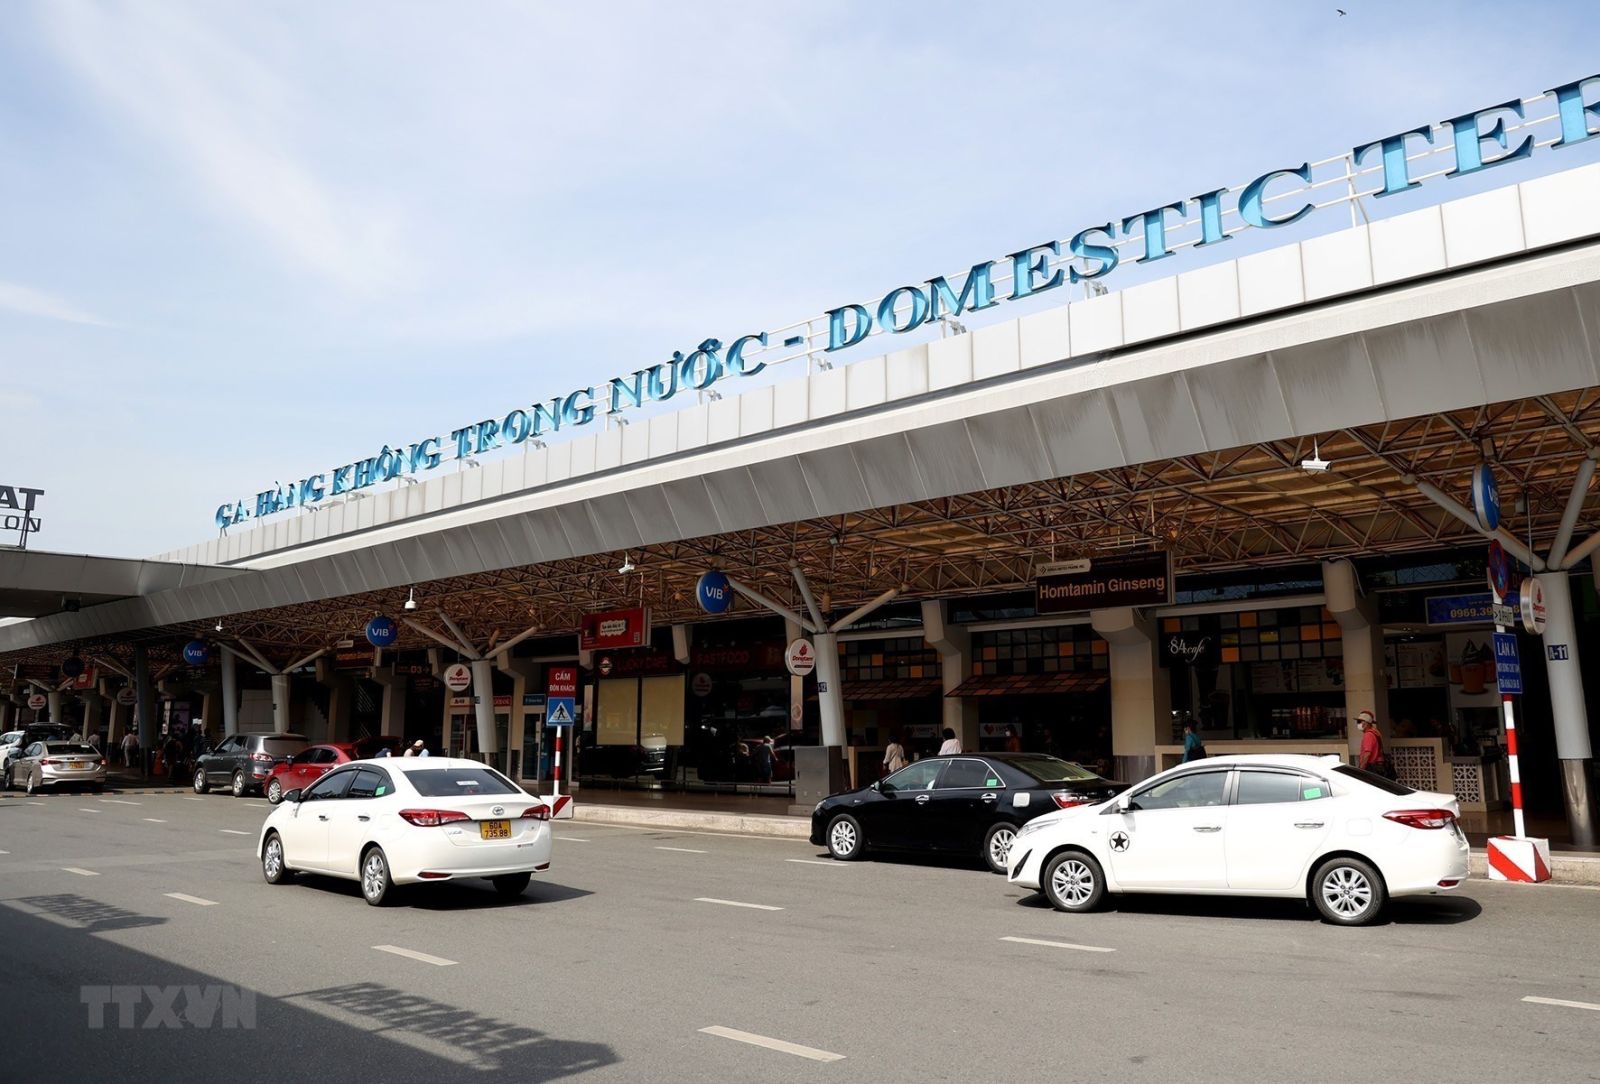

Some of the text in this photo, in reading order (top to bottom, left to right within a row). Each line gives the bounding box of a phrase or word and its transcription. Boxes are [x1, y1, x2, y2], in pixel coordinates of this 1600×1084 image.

[254, 474, 324, 517] HÀNG
[330, 437, 441, 496] KHÔNG
[452, 387, 594, 460] TRONG
[609, 332, 768, 413] NƯỚC
[825, 162, 1315, 352] DOMESTIC
[705, 585, 723, 599] VIB
[1040, 577, 1165, 599] Homtamin Ginseng
[371, 628, 390, 636] VIB
[1549, 646, 1567, 659] A-11
